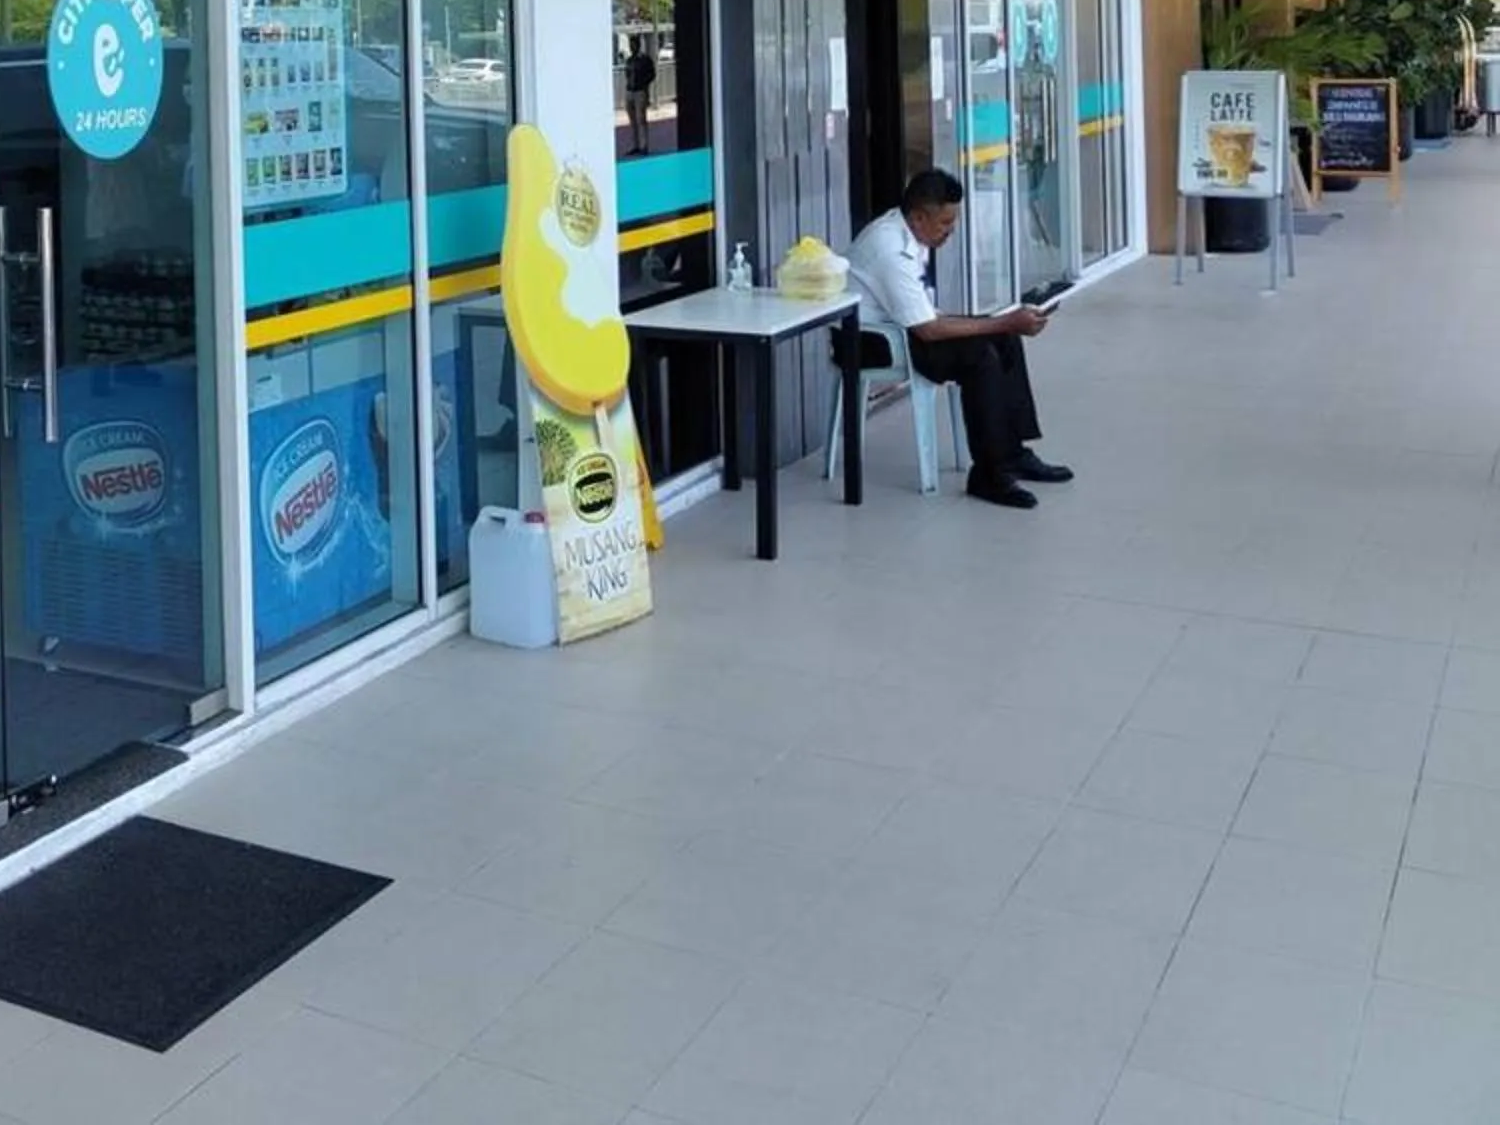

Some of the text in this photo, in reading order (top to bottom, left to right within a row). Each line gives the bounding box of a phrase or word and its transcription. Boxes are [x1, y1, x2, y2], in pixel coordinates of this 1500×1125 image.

[76, 107, 146, 131] 24 HOURS
[586, 559, 627, 600] KING
